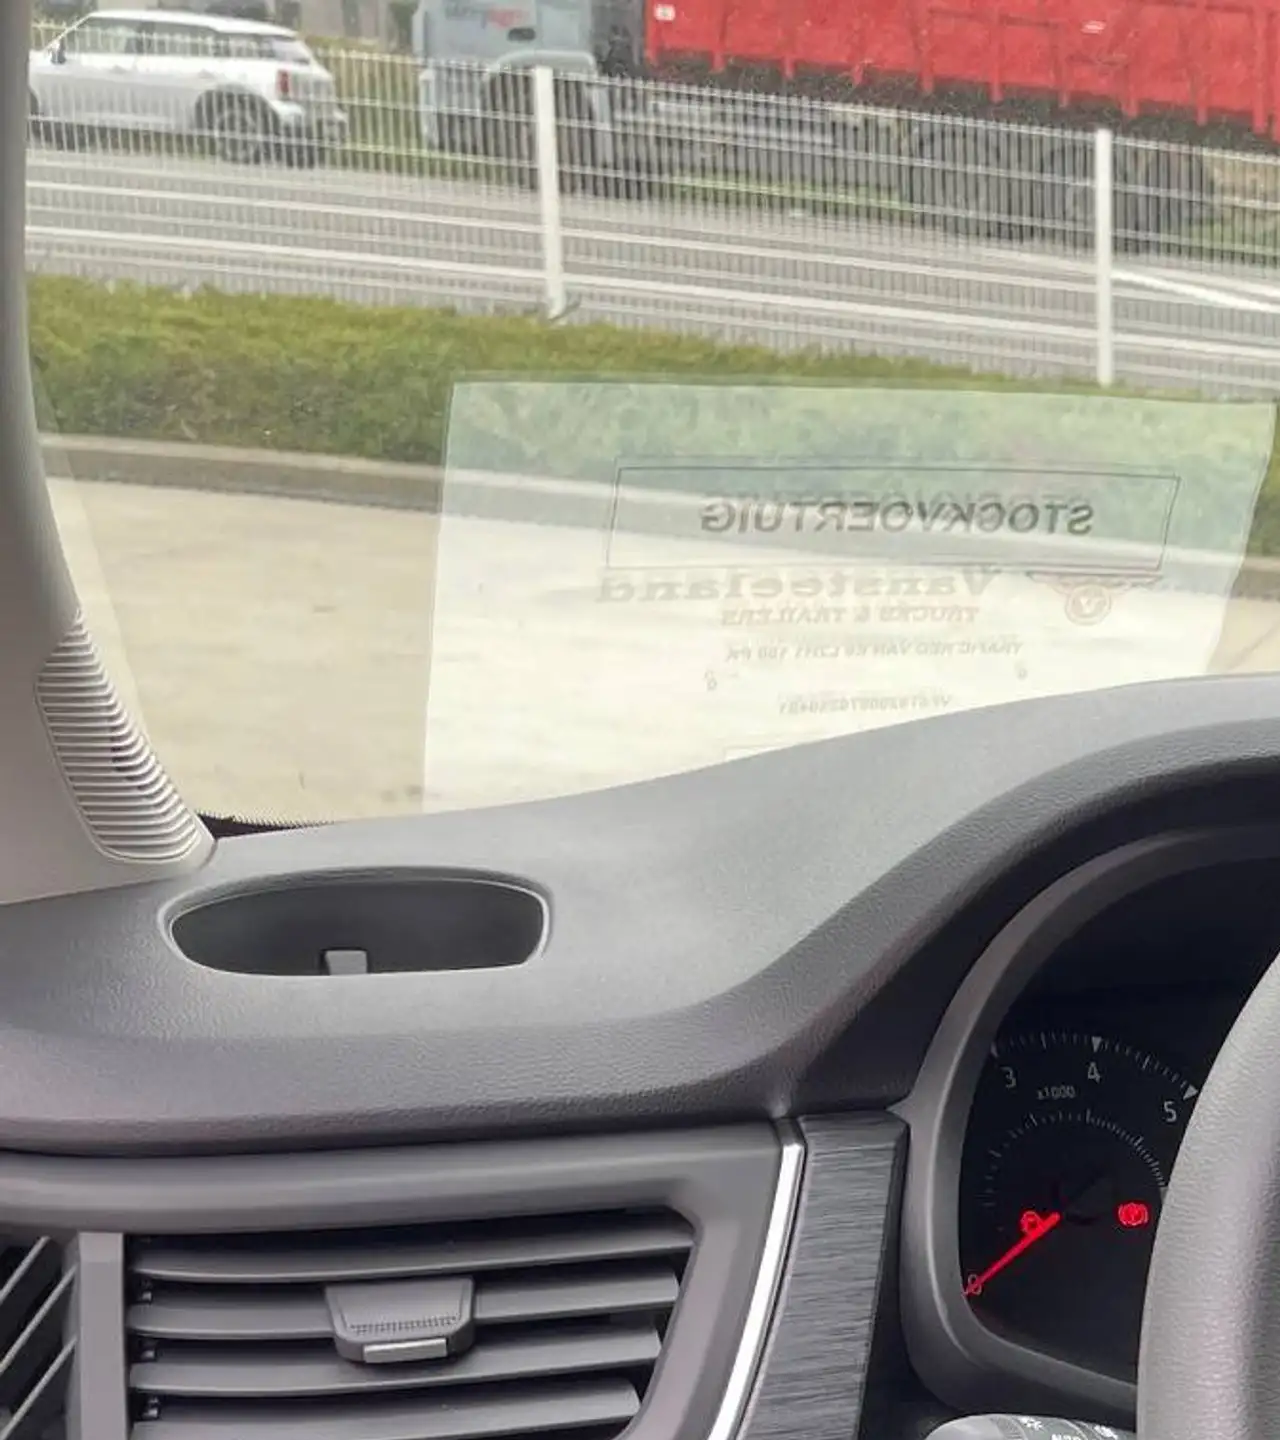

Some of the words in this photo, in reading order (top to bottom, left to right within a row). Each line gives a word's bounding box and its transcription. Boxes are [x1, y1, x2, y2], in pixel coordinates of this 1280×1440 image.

[1001, 1066, 1017, 1089] 3
[1086, 1062, 1102, 1084] 4
[1163, 1100, 1178, 1123] 5
